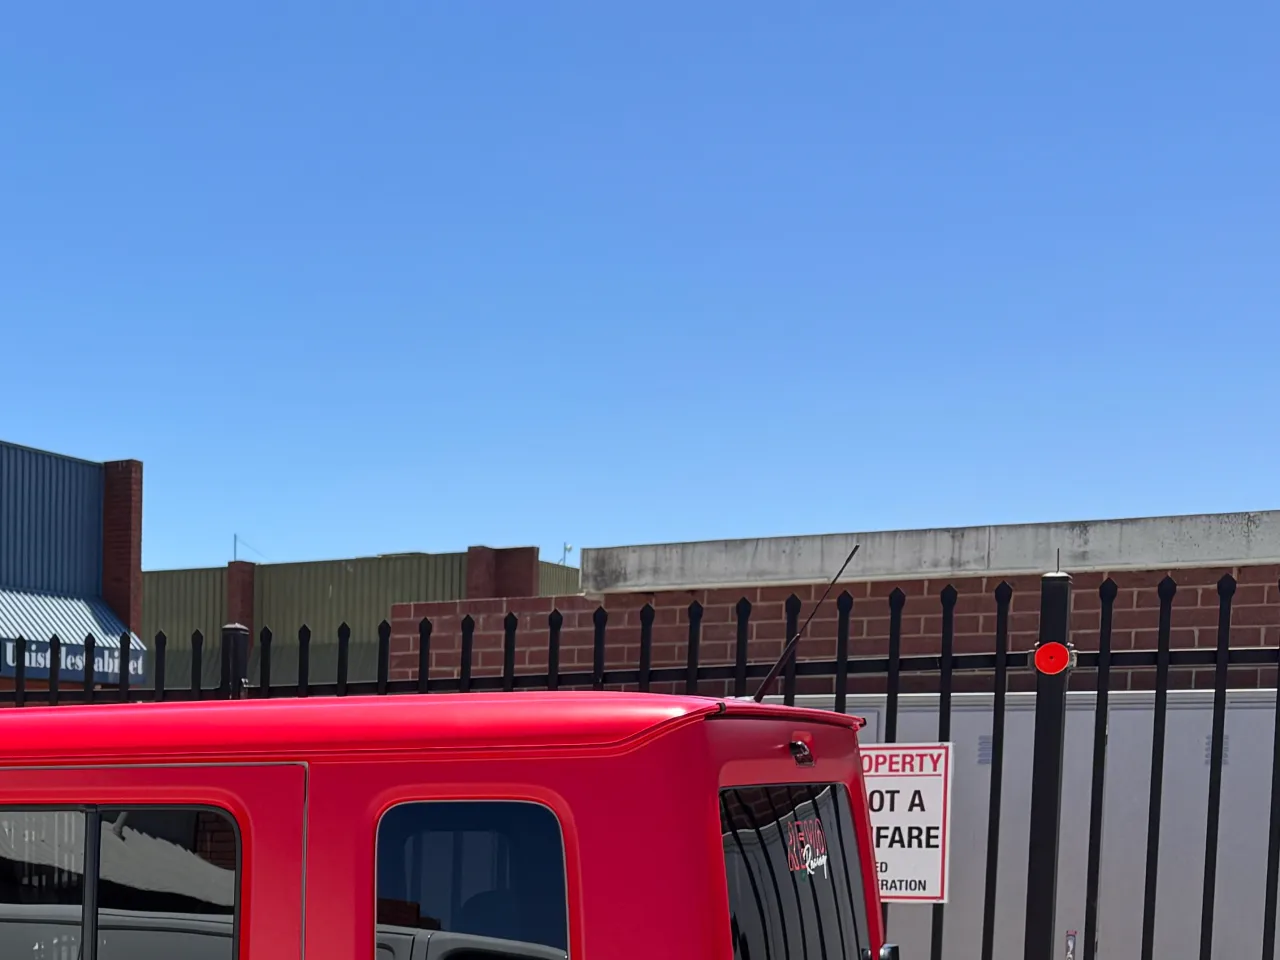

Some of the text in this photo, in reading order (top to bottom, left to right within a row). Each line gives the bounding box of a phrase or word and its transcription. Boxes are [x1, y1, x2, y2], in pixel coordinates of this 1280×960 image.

[5, 641, 84, 671] Unistles
[908, 789, 926, 812] A
[871, 826, 940, 849] FARE
[877, 879, 927, 892] RATION
